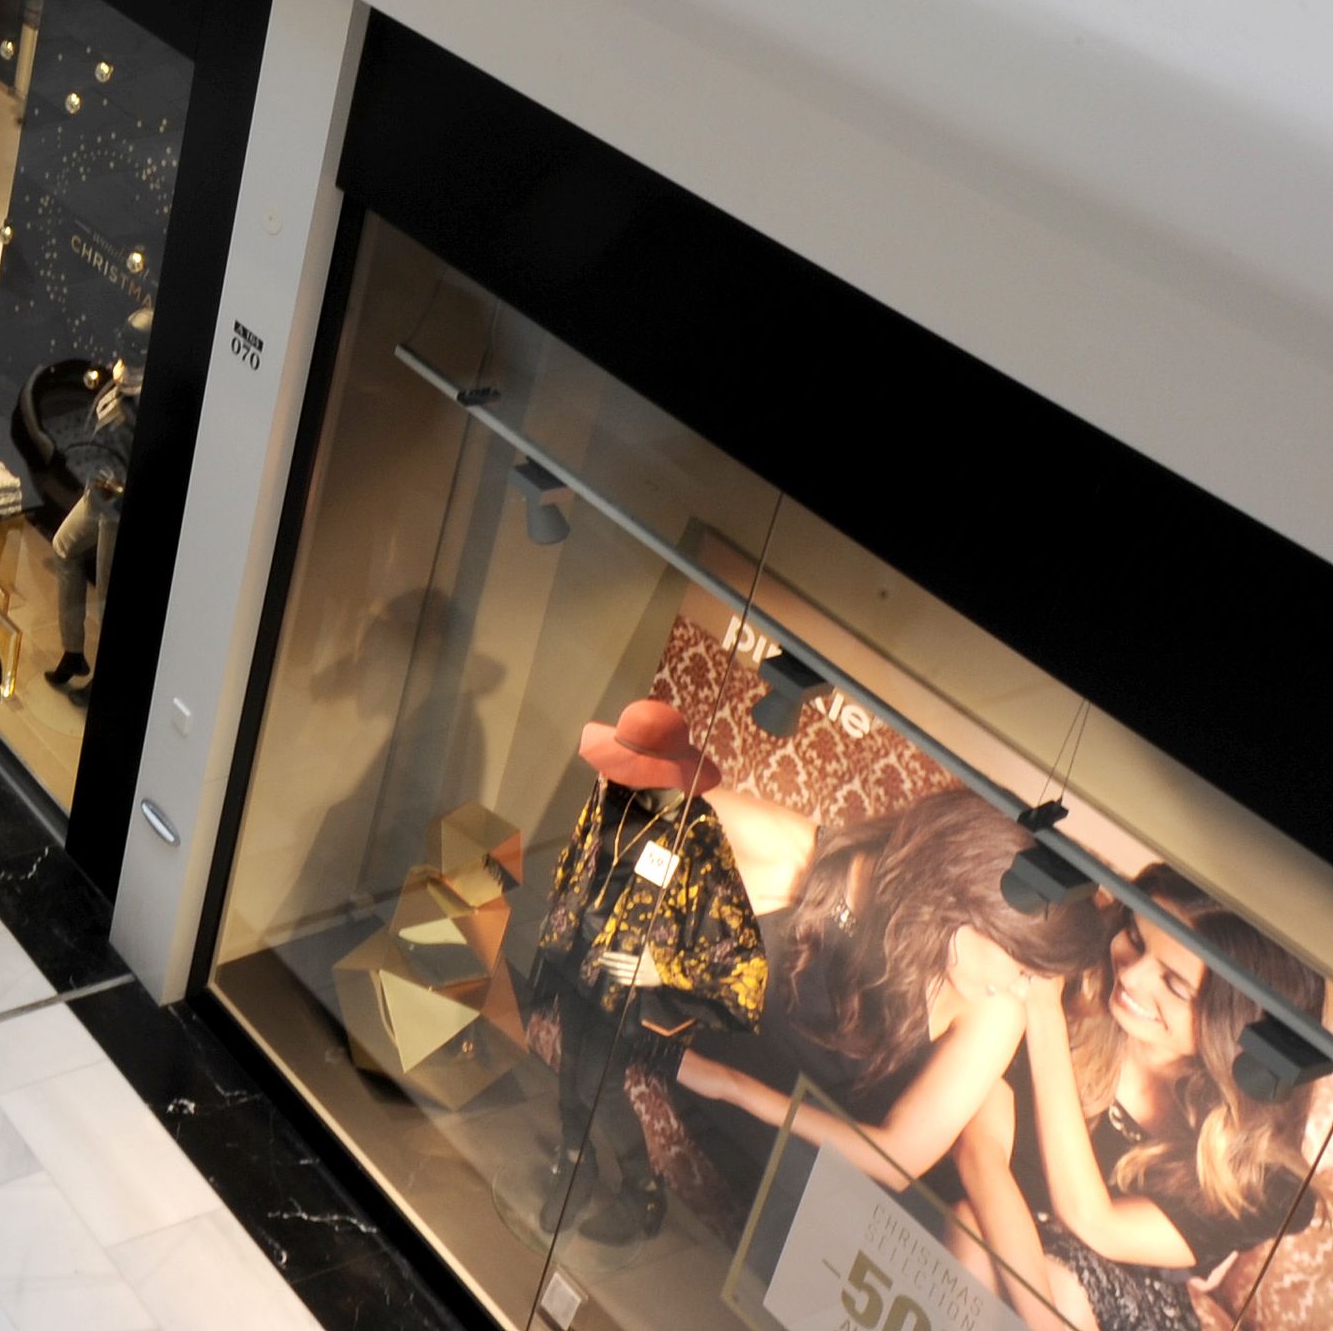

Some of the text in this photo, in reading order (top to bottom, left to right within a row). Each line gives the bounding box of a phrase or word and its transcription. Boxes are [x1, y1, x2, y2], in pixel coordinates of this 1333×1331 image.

[71, 235, 153, 310] CHRISTMA
[231, 337, 260, 371] 070
[872, 1204, 983, 1317] CHRISTMAS
